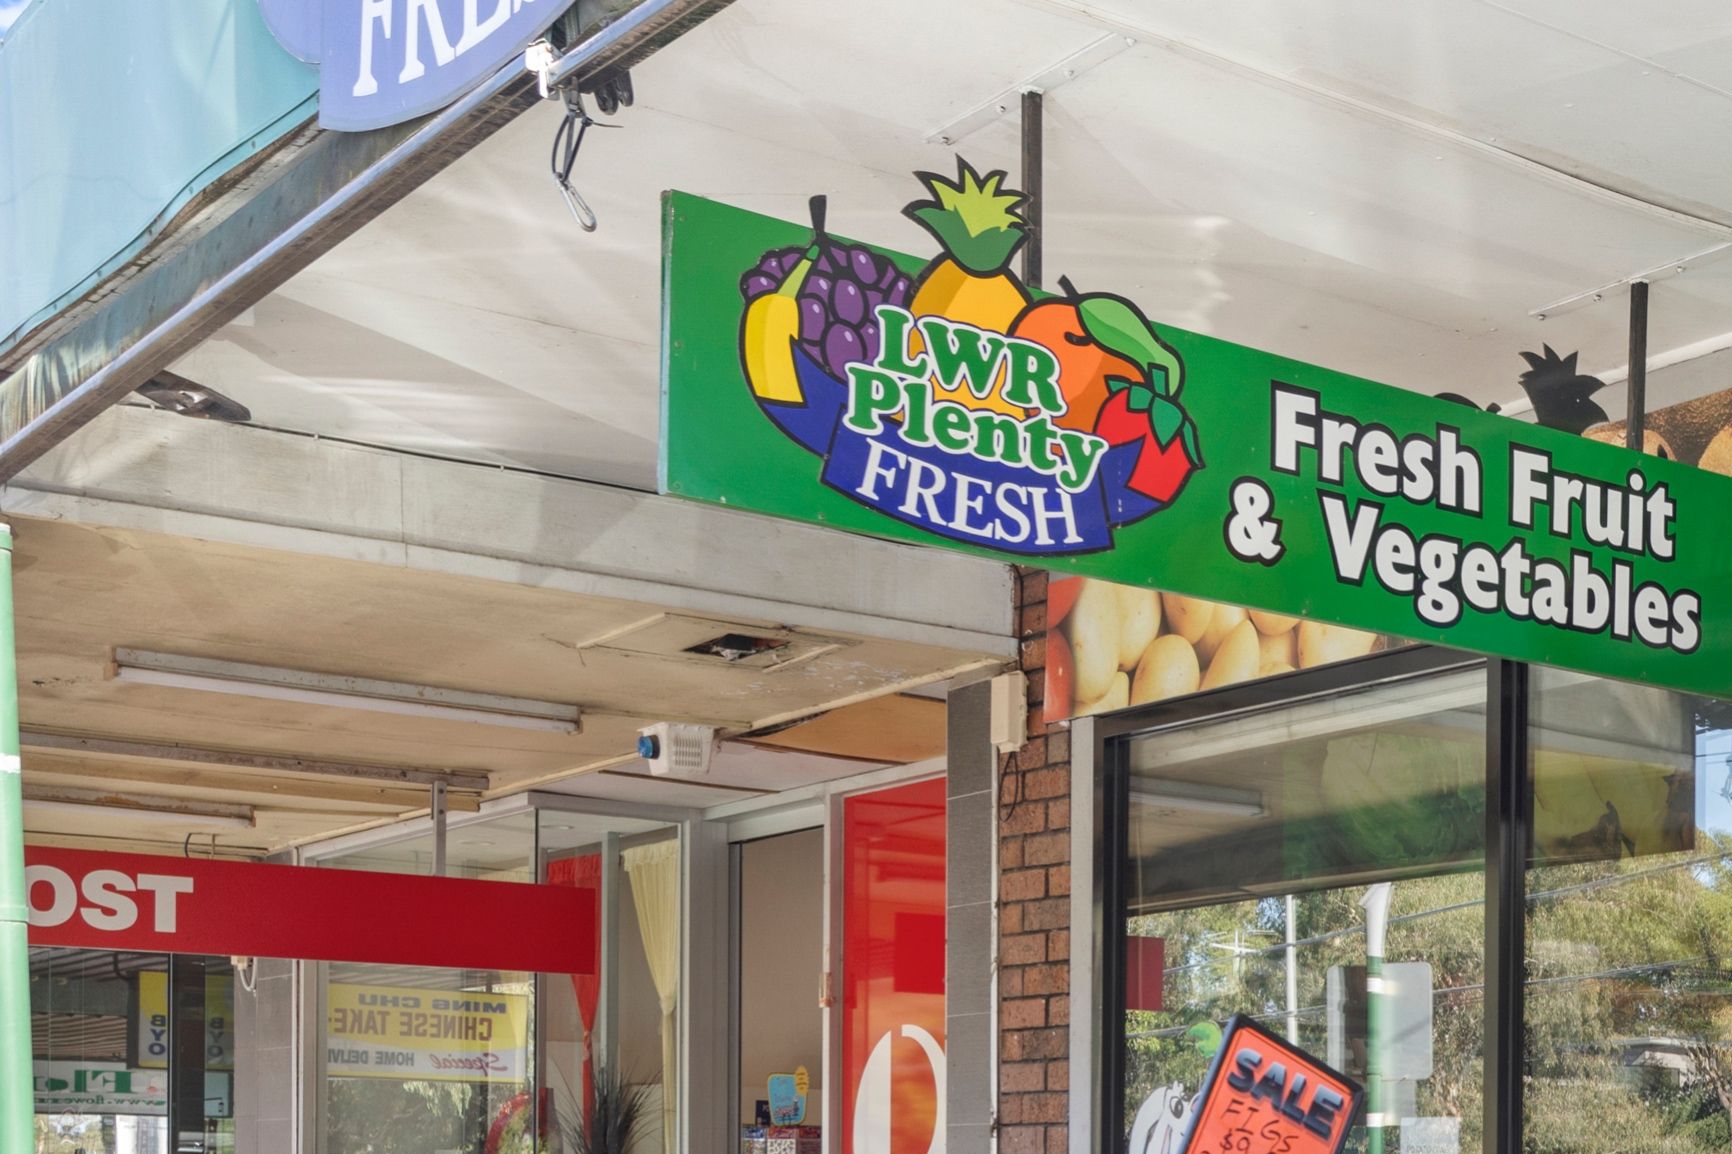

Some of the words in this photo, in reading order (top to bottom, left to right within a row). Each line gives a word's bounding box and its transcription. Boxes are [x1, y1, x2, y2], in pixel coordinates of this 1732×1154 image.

[877, 305, 1068, 415] LWR
[843, 362, 1109, 493] Plenty
[1273, 388, 1481, 514] Fresh
[1511, 448, 1676, 560] Fruit
[856, 438, 1084, 546] FRESH
[1227, 481, 1284, 562] &
[1321, 495, 1700, 652] Vegetables
[26, 865, 194, 933] OST
[1221, 1098, 1299, 1153] FIGS
[1227, 1047, 1344, 1141] SALE
